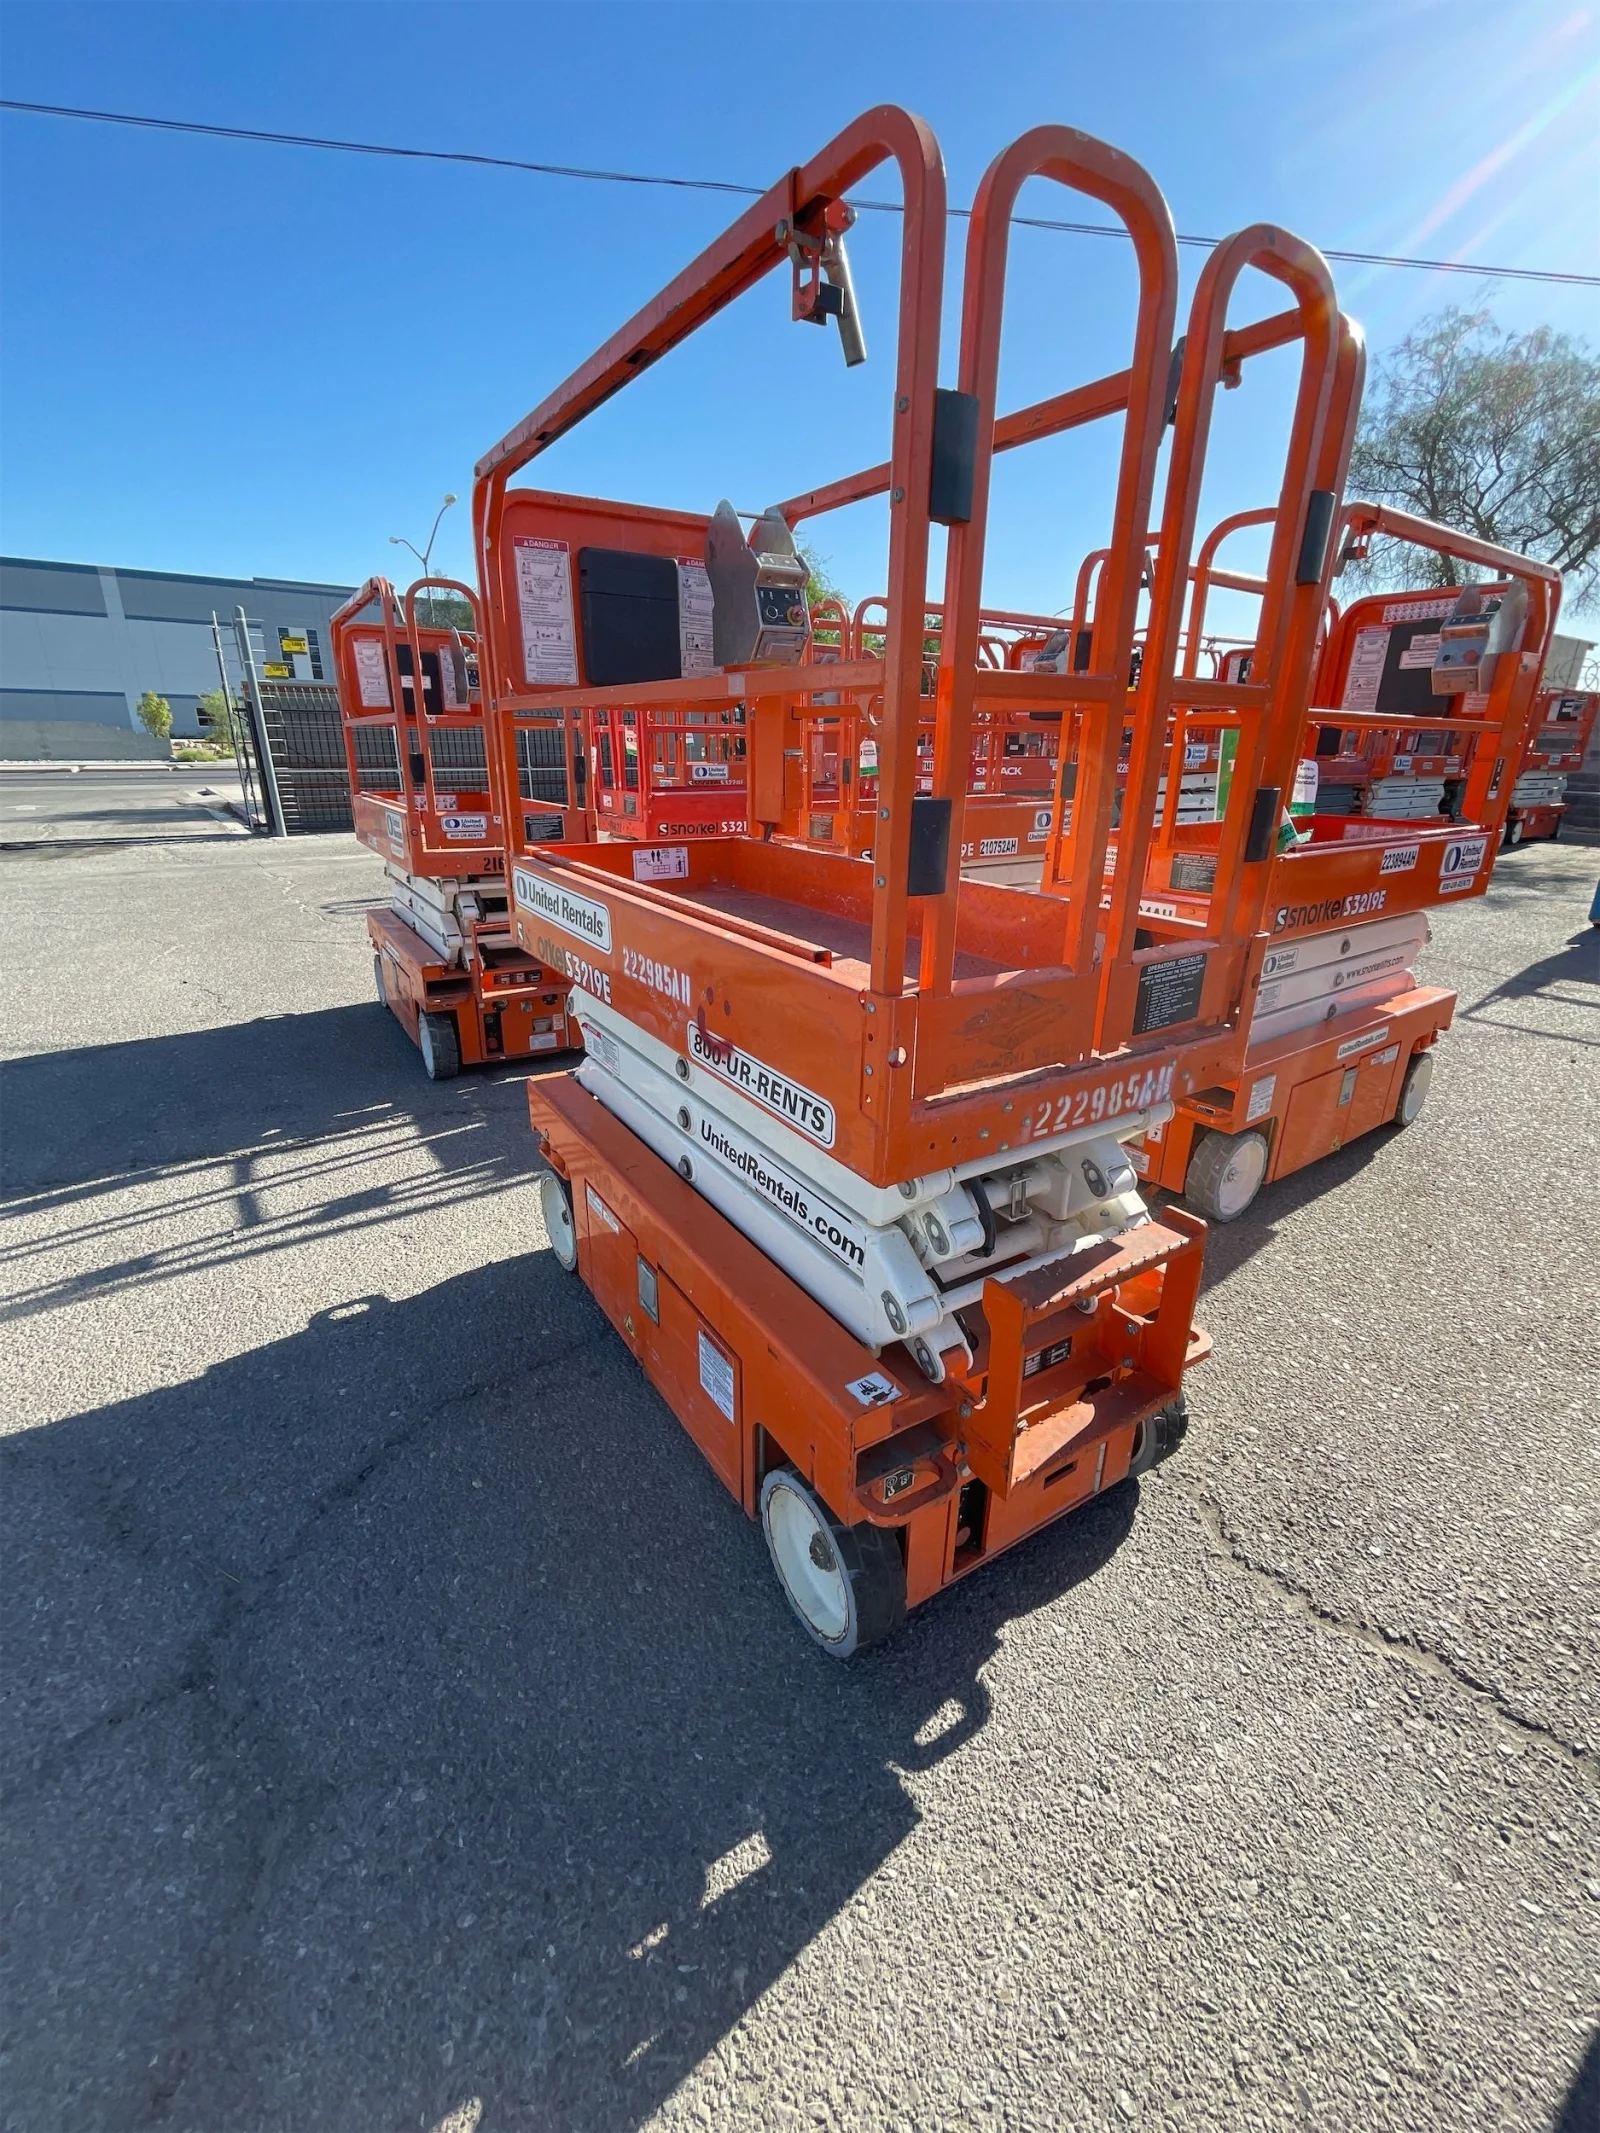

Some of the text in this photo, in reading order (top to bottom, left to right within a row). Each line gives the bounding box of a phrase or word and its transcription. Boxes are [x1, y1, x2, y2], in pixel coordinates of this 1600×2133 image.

[528, 540, 559, 549] DANGER
[975, 766, 1022, 776] SKACK
[670, 822, 719, 835] snorkel
[721, 820, 747, 833] S321
[980, 839, 1017, 855] 210752AH
[1462, 843, 1484, 857] United
[1459, 855, 1481, 870] Rentals
[527, 881, 604, 938] United Rentals
[1287, 896, 1346, 929] snorkel
[1343, 889, 1387, 917] S3219E
[1148, 955, 1203, 972] OPERATORS CHECKLIST
[1277, 951, 1296, 963] United
[1276, 960, 1295, 971] Rentals
[622, 945, 691, 1008] 222985AH
[693, 1033, 827, 1134] 800-UR-RENTS
[1033, 1062, 1175, 1137] 222985AH
[701, 1119, 866, 1267] UnitedRentals.com
